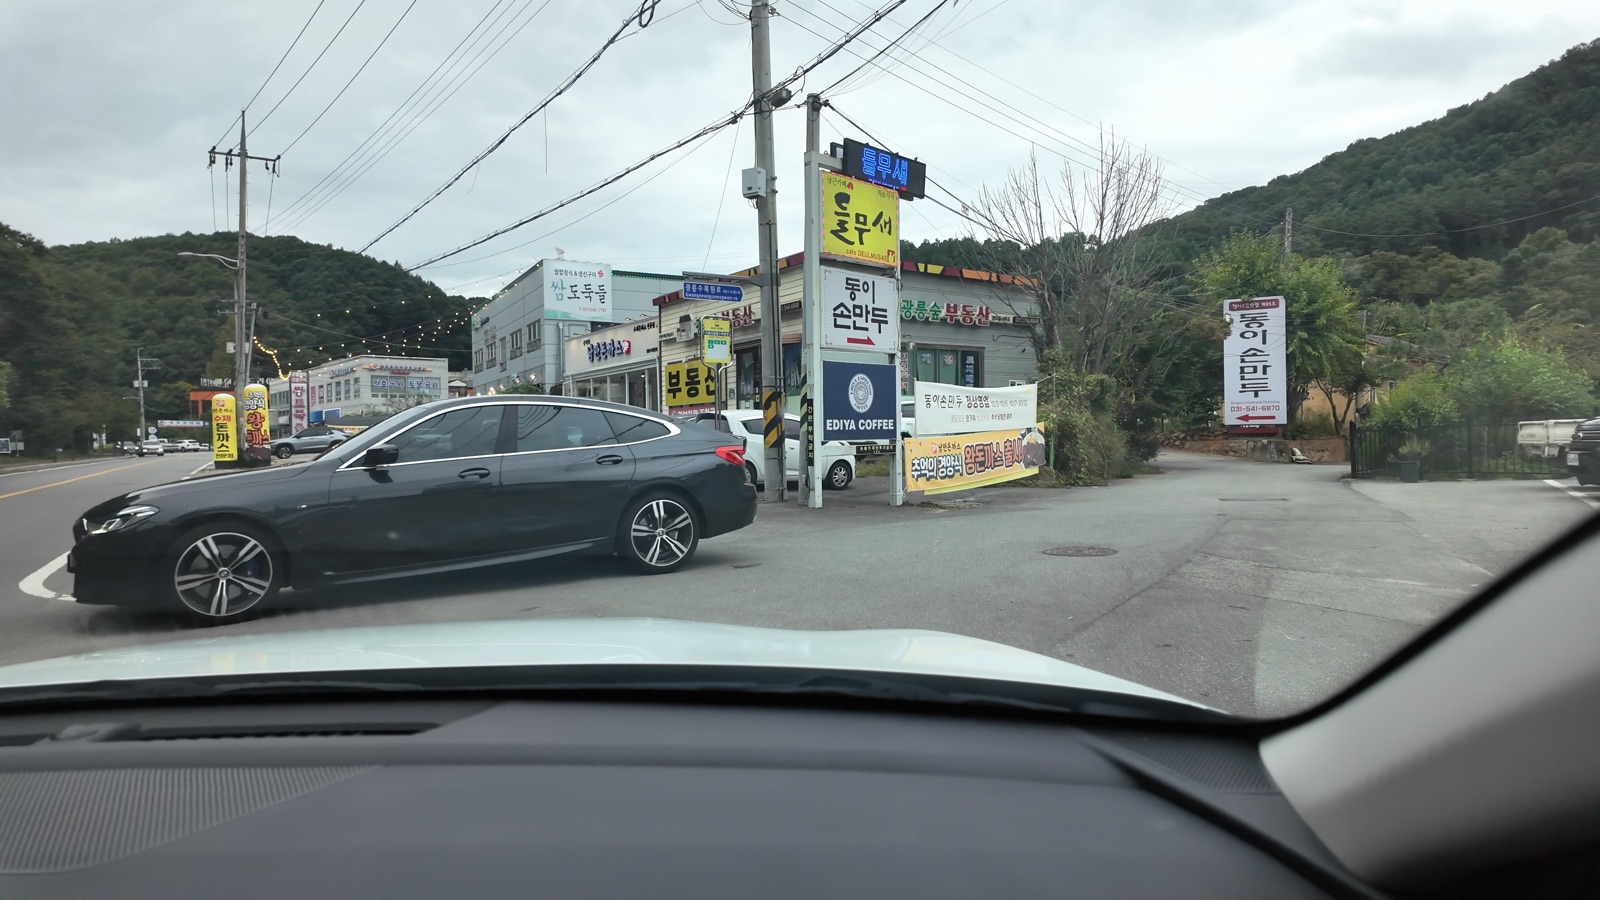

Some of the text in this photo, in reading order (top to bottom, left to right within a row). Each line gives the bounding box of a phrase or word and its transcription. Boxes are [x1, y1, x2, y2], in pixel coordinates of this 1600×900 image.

[862, 148, 908, 186] 들무새
[830, 192, 892, 246] 들무새
[858, 250, 888, 261] DEULMUSAE
[551, 278, 607, 304] 쌈도둑들
[845, 277, 875, 304] 동이
[832, 302, 889, 334] 손만두
[901, 299, 990, 325] 광릉숲 부동산
[1239, 312, 1271, 399] 동이손만두
[924, 394, 963, 409] 동이손만두
[965, 395, 990, 409] 정상영업
[246, 411, 265, 430] 왕
[826, 419, 894, 430] EDIYA COFFEE
[216, 423, 230, 452] 돈까스
[938, 442, 962, 453] 낭만돈까스
[911, 456, 938, 481] 추억의
[938, 453, 963, 478] 경양식
[964, 441, 1004, 475] 왕돈까스
